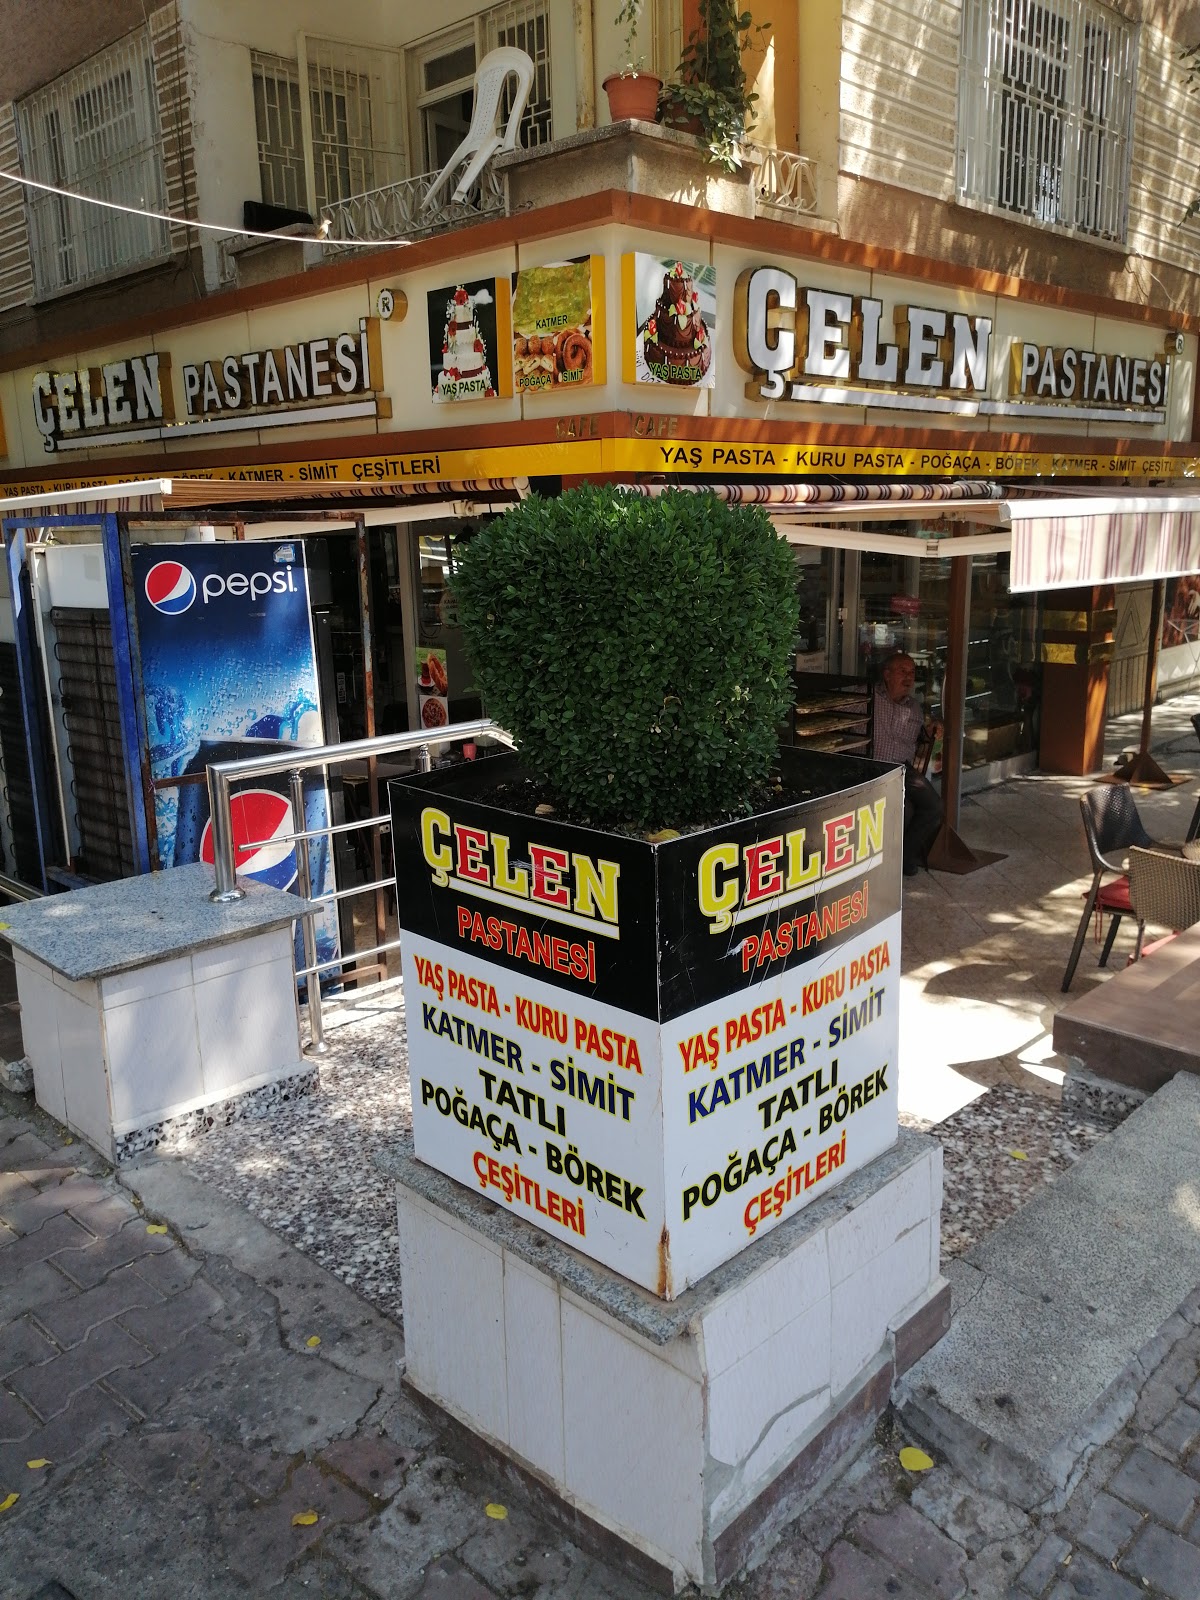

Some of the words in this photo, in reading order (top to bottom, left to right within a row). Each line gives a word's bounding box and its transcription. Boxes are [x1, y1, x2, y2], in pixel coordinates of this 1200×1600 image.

[535, 314, 568, 330] KATMER
[747, 266, 992, 399] ÇELEN
[1020, 341, 1171, 406] PASTANESİ
[32, 353, 163, 452] ÇELEN
[183, 316, 371, 415] PASTANESİ
[441, 383, 458, 396] YAŞ
[458, 379, 487, 394] PASTA
[519, 373, 552, 388] POĞAÇA
[563, 369, 584, 382] SİMİT
[649, 362, 669, 380] YAŞ
[671, 365, 703, 380] PASTA
[556, 416, 599, 438] CAFE
[634, 415, 678, 438] CAFE
[660, 446, 703, 468] YAŞ
[712, 448, 776, 466] PASTA
[796, 451, 846, 468] KURU
[853, 453, 904, 468] PASTA
[921, 452, 981, 472] POĞAÇA
[995, 455, 1040, 470] BÖREK
[1052, 458, 1098, 471] KATMER
[1109, 458, 1137, 471] SİMİT
[21, 485, 46, 496] PASTA
[228, 469, 284, 481] KATMER
[298, 462, 339, 481] SİMİT
[352, 455, 441, 481] ÇEŞİTLERİ
[420, 806, 621, 925] ÇELEN
[697, 796, 887, 935] ÇELEN
[456, 904, 597, 984] PASTANESİ
[741, 879, 869, 973] PASTANESİ
[413, 953, 445, 1001] YAŞ
[448, 968, 501, 1018] PASTA
[515, 995, 568, 1044] KURU
[574, 1016, 643, 1075] PASTA
[678, 1026, 719, 1074] YAŞ
[725, 997, 787, 1055] PASTA
[802, 965, 846, 1017] KURU
[850, 940, 891, 996] PASTA
[421, 1002, 525, 1075] KATMER
[550, 1054, 635, 1122] SİMİT
[688, 1036, 806, 1125] KATMER
[828, 986, 887, 1049] SİMİT
[758, 1058, 839, 1130] TATLI
[478, 1067, 567, 1137] TATLI
[682, 1126, 797, 1222] POĞAÇA
[818, 1064, 889, 1136] BÖREK
[421, 1078, 523, 1155] POĞAÇA
[545, 1138, 648, 1222] BÖREK
[473, 1150, 587, 1237] ÇEŞİTLERİ
[743, 1129, 847, 1236] ÇEŞİTLERİ
